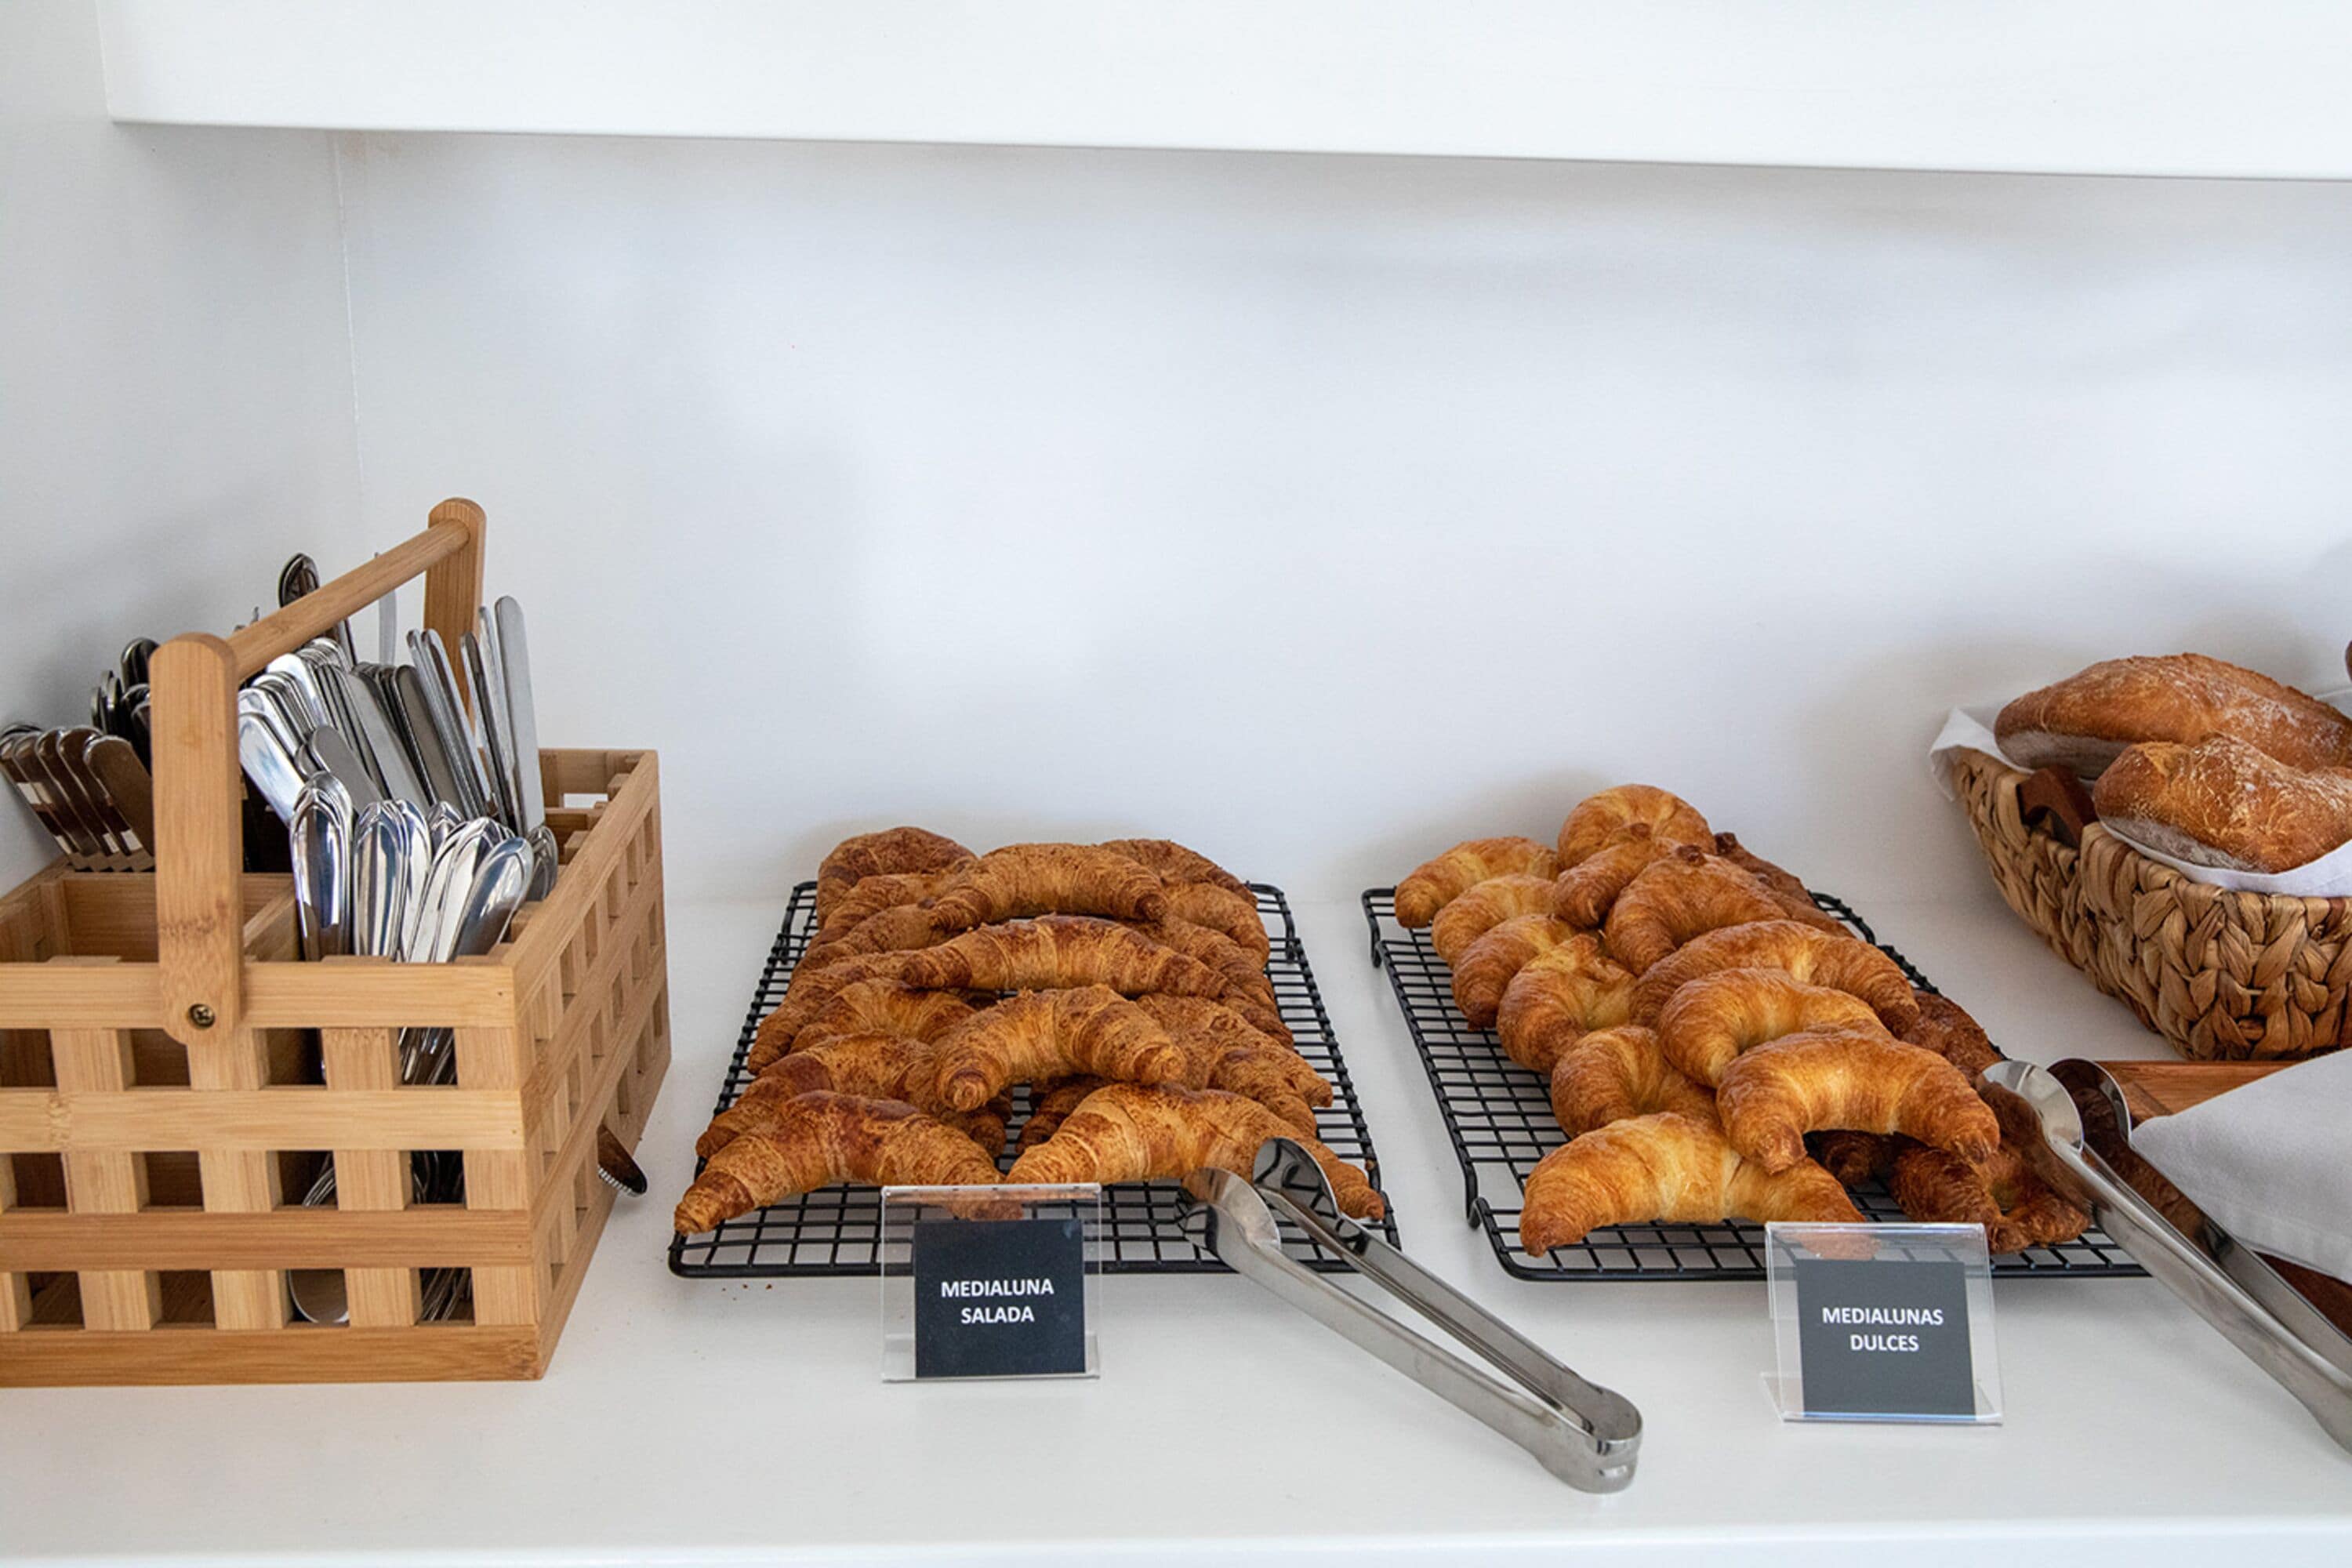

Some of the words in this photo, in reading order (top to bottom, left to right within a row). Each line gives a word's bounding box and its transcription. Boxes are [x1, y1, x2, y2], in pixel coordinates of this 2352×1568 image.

[941, 1279, 1054, 1297] MEDIALUNA
[960, 1306, 1035, 1324] SALADA
[1822, 1307, 1944, 1326] MEDIALUNAS
[1849, 1334, 1920, 1352] DULCES
